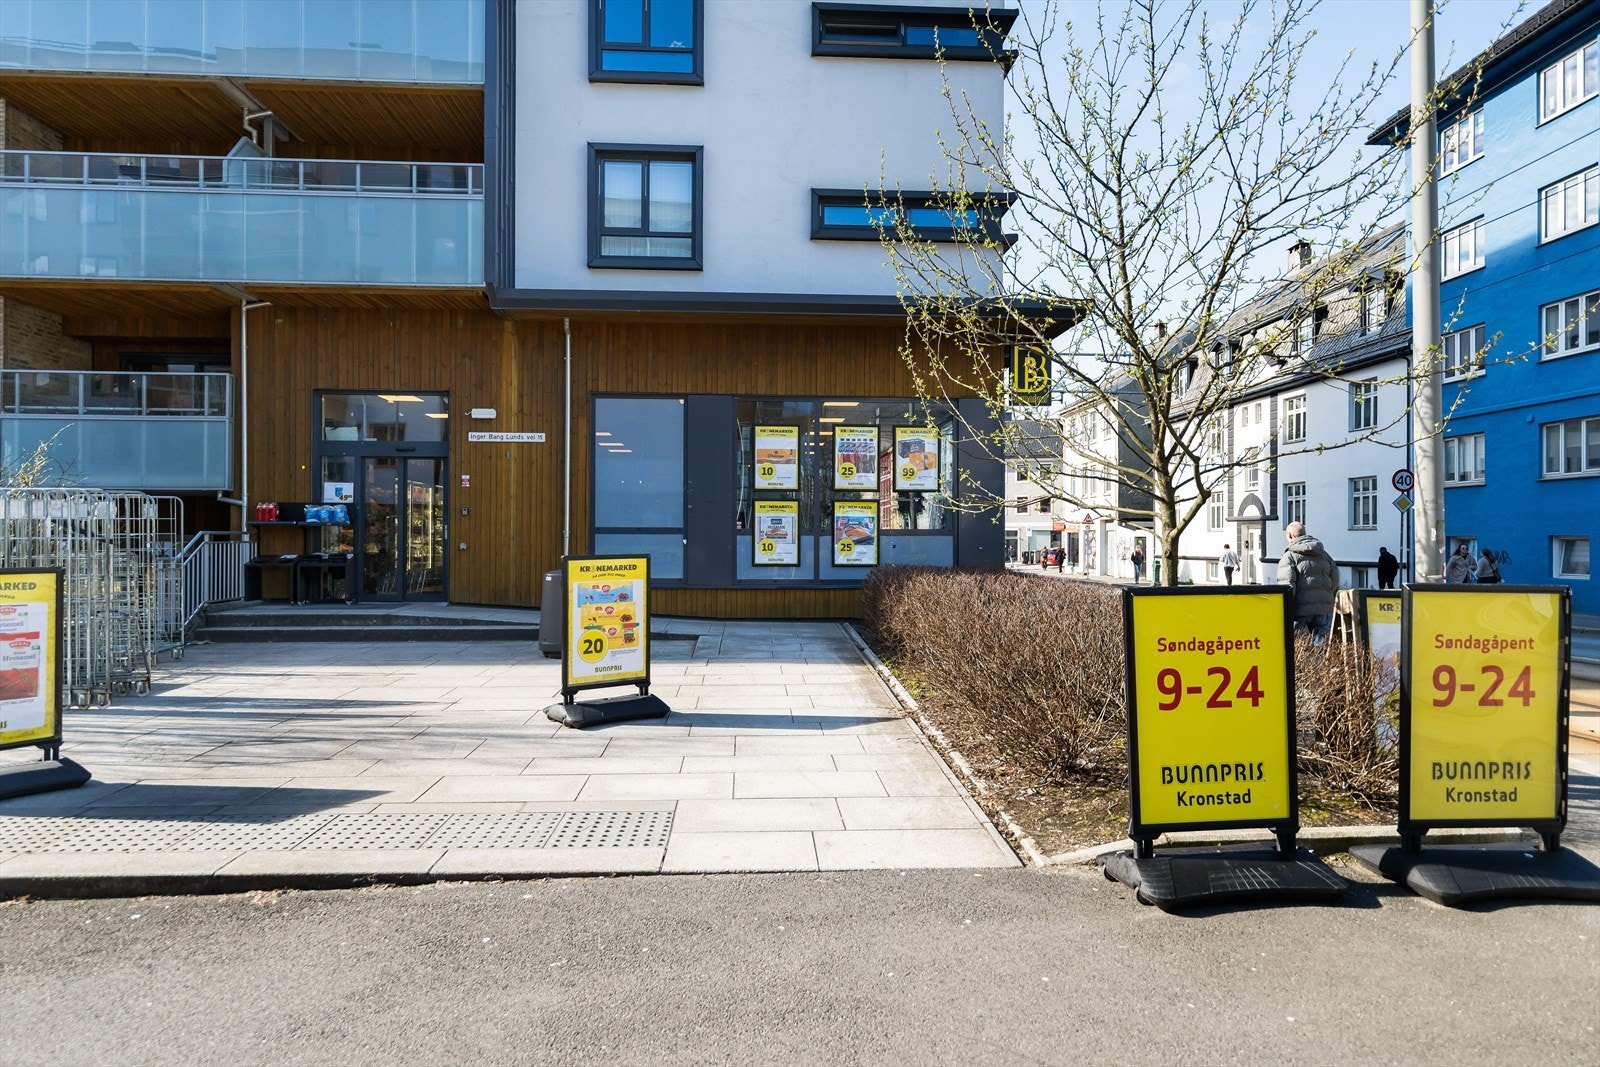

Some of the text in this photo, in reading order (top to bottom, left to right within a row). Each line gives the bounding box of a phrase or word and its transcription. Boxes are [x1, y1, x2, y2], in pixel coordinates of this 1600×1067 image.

[761, 467, 773, 475] 10
[841, 467, 854, 475] 25
[902, 468, 915, 476] 99
[1396, 475, 1412, 486] 40
[761, 543, 774, 551] 10
[840, 543, 852, 552] 25
[583, 638, 604, 654] 20
[1157, 635, 1261, 656] Søndagåpent
[1434, 633, 1535, 654] Søndagåpent
[1157, 665, 1265, 711] 9-24
[1432, 664, 1536, 708] 9-24
[1161, 761, 1264, 785] BUNNPRIS
[1432, 761, 1531, 780] BUNNPRIS
[1177, 788, 1252, 807] Kronstad
[1446, 787, 1518, 803] Kronstad
